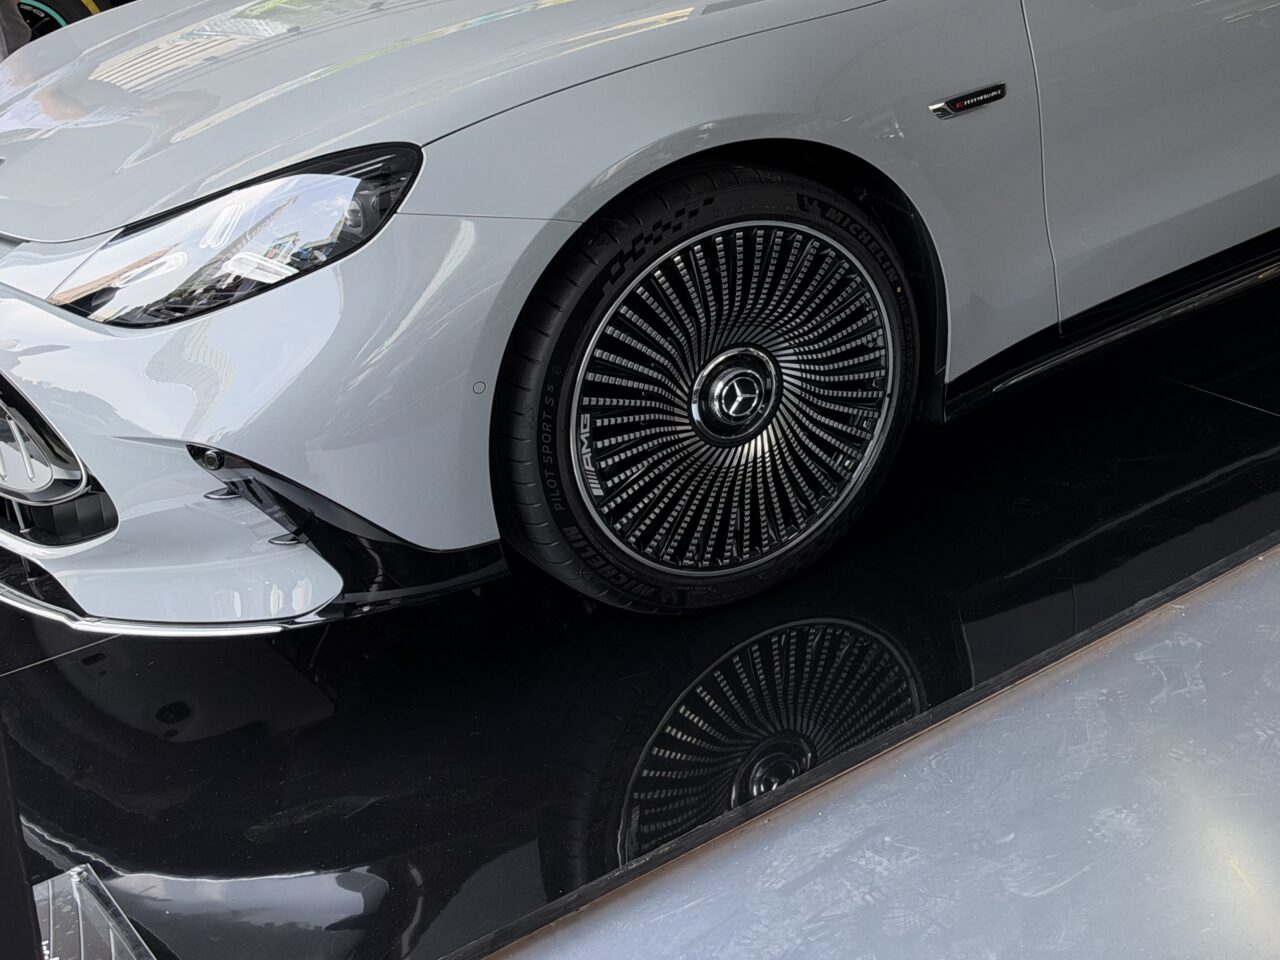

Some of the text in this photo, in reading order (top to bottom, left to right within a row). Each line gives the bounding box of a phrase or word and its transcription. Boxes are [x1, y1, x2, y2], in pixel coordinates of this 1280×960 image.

[824, 208, 899, 283] MICHELIN
[541, 410, 553, 464] SPORT
[546, 468, 565, 513] PILOT
[563, 525, 656, 596] MICHELIN
